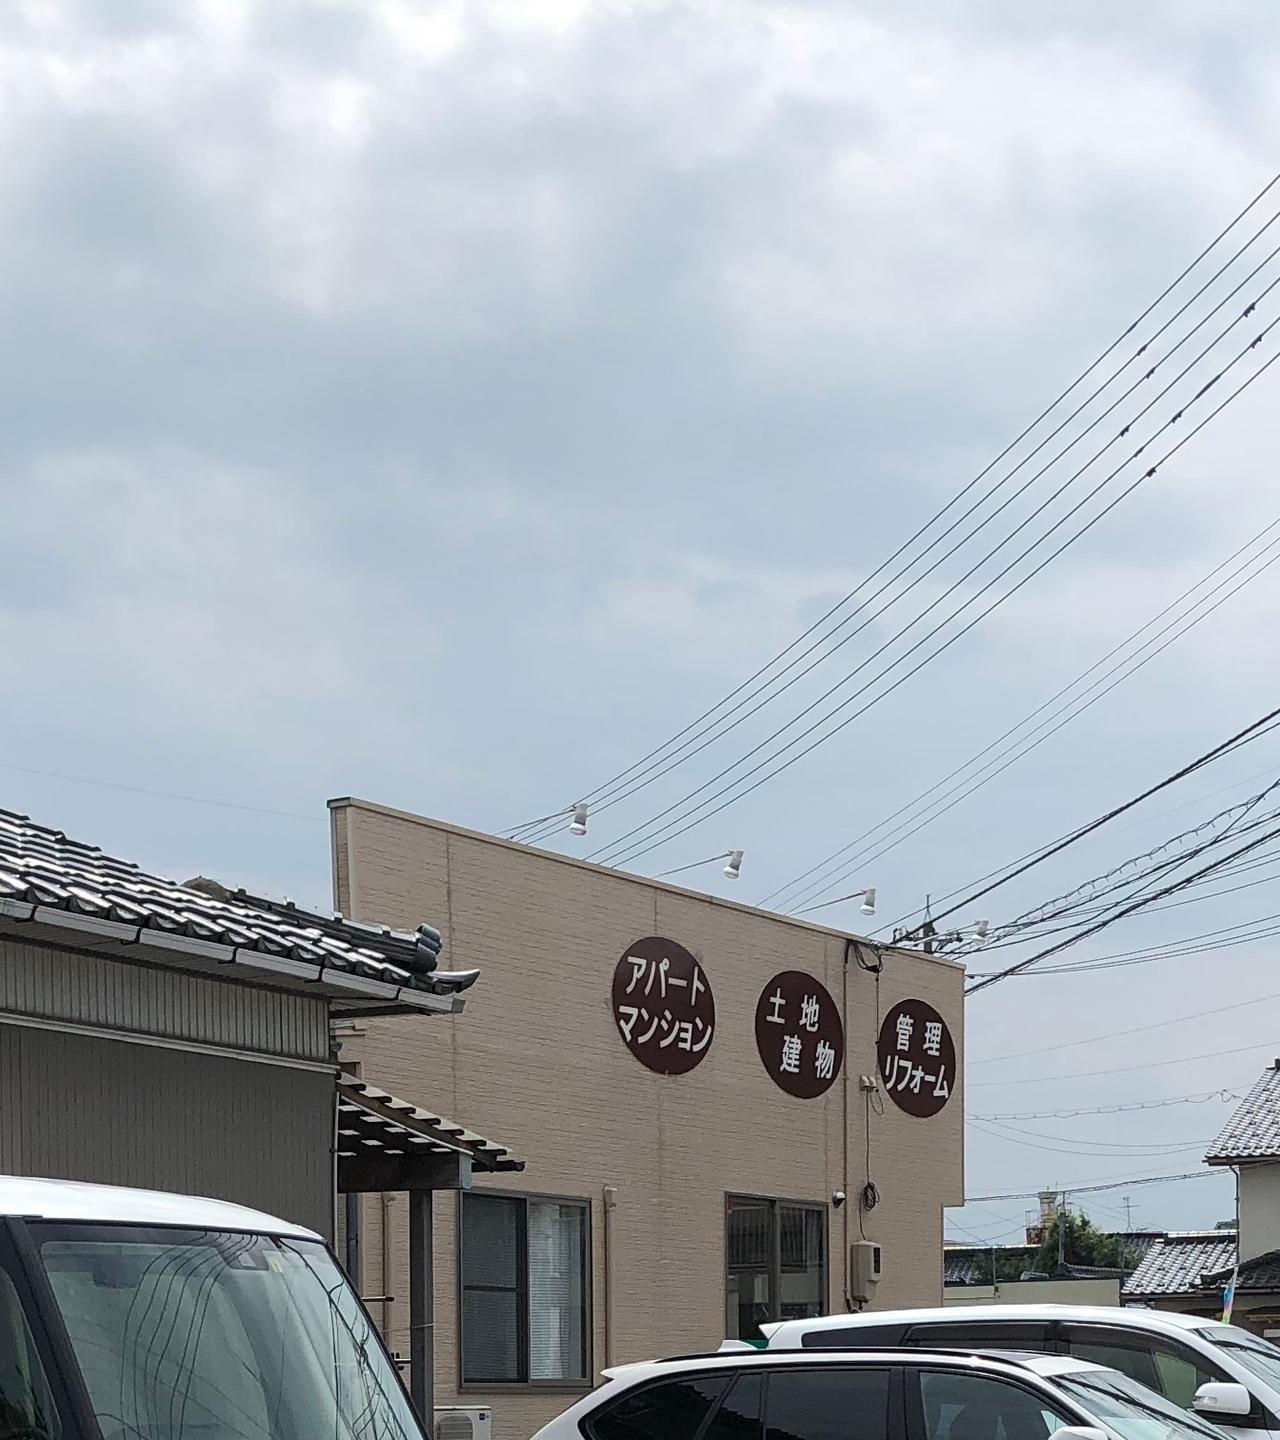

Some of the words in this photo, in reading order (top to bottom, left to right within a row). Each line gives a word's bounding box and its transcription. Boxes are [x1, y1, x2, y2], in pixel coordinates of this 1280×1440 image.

[626, 955, 706, 1007] アパート
[618, 1004, 713, 1054] マンション
[765, 987, 819, 1034] 土地
[779, 1033, 835, 1080] 建物
[895, 1012, 943, 1058] 管理
[884, 1053, 950, 1100] リフォーム
